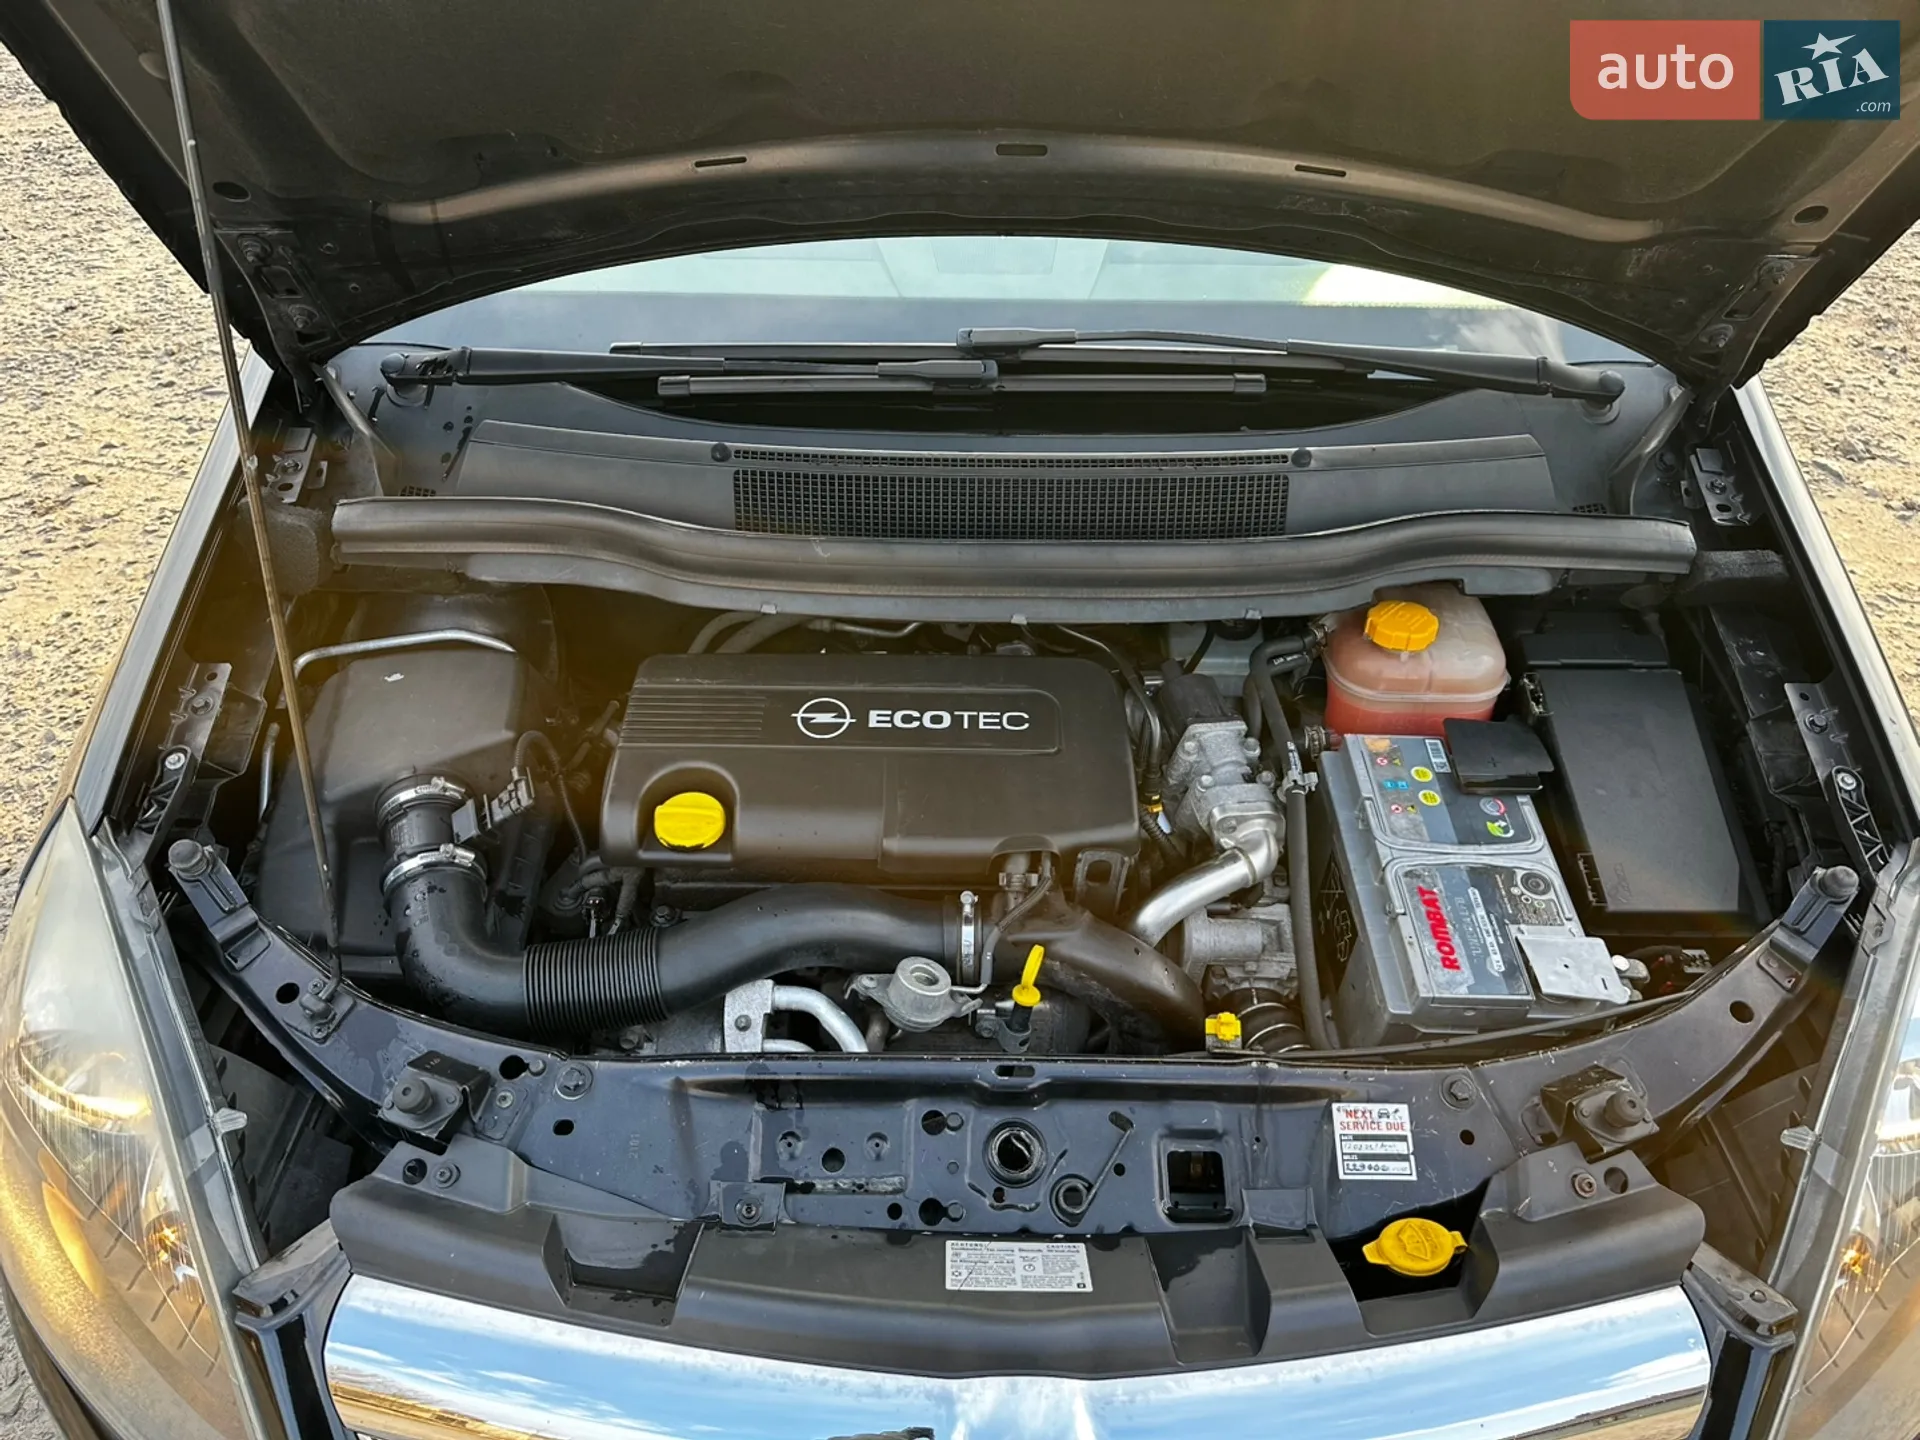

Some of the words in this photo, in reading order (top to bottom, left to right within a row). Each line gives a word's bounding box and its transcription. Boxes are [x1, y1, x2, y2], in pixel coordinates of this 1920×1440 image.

[868, 709, 1030, 730] ECOTEC
[1416, 885, 1461, 972] ROMBAT
[1345, 1108, 1373, 1120] NEXT
[1340, 1121, 1383, 1131] SERVICE
[1386, 1121, 1406, 1131] DUE
